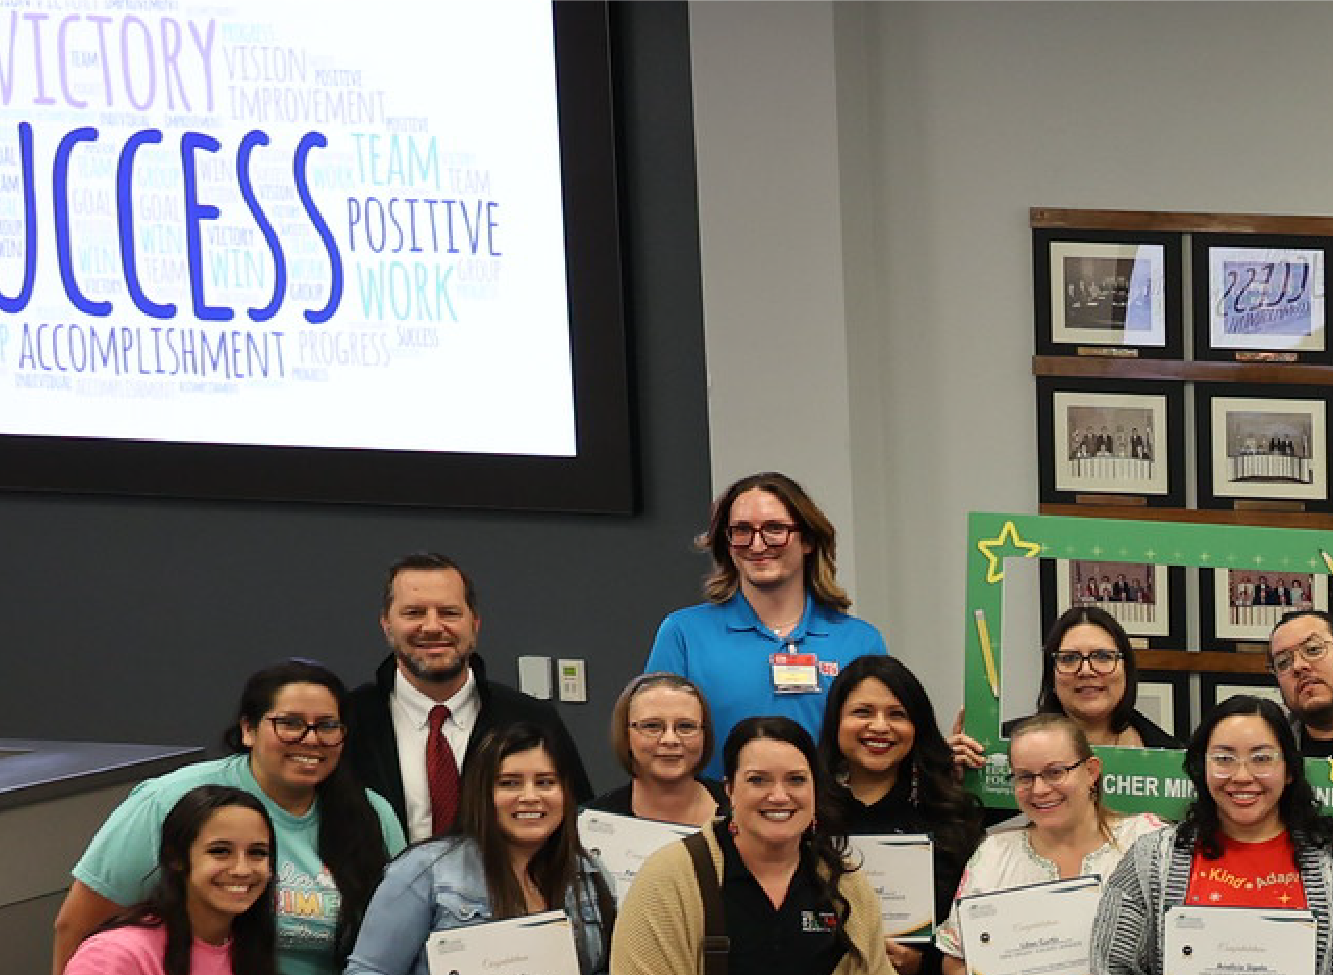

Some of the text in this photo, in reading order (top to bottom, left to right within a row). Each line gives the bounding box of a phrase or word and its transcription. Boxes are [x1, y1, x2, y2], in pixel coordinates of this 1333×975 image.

[0, 10, 216, 112] VICTORY
[222, 45, 307, 83] VISION
[227, 85, 387, 125] IMPROVEMENT
[350, 132, 441, 191] TEAM
[447, 167, 491, 195] TEAM
[140, 223, 183, 255] WIN
[346, 197, 502, 257] POSITIVE
[208, 249, 266, 289] WIN
[356, 260, 458, 323] WORK
[18, 321, 286, 379] ACCOMPLISHMENT
[298, 329, 391, 367] PROGRESS
[1102, 773, 1160, 797] CHER
